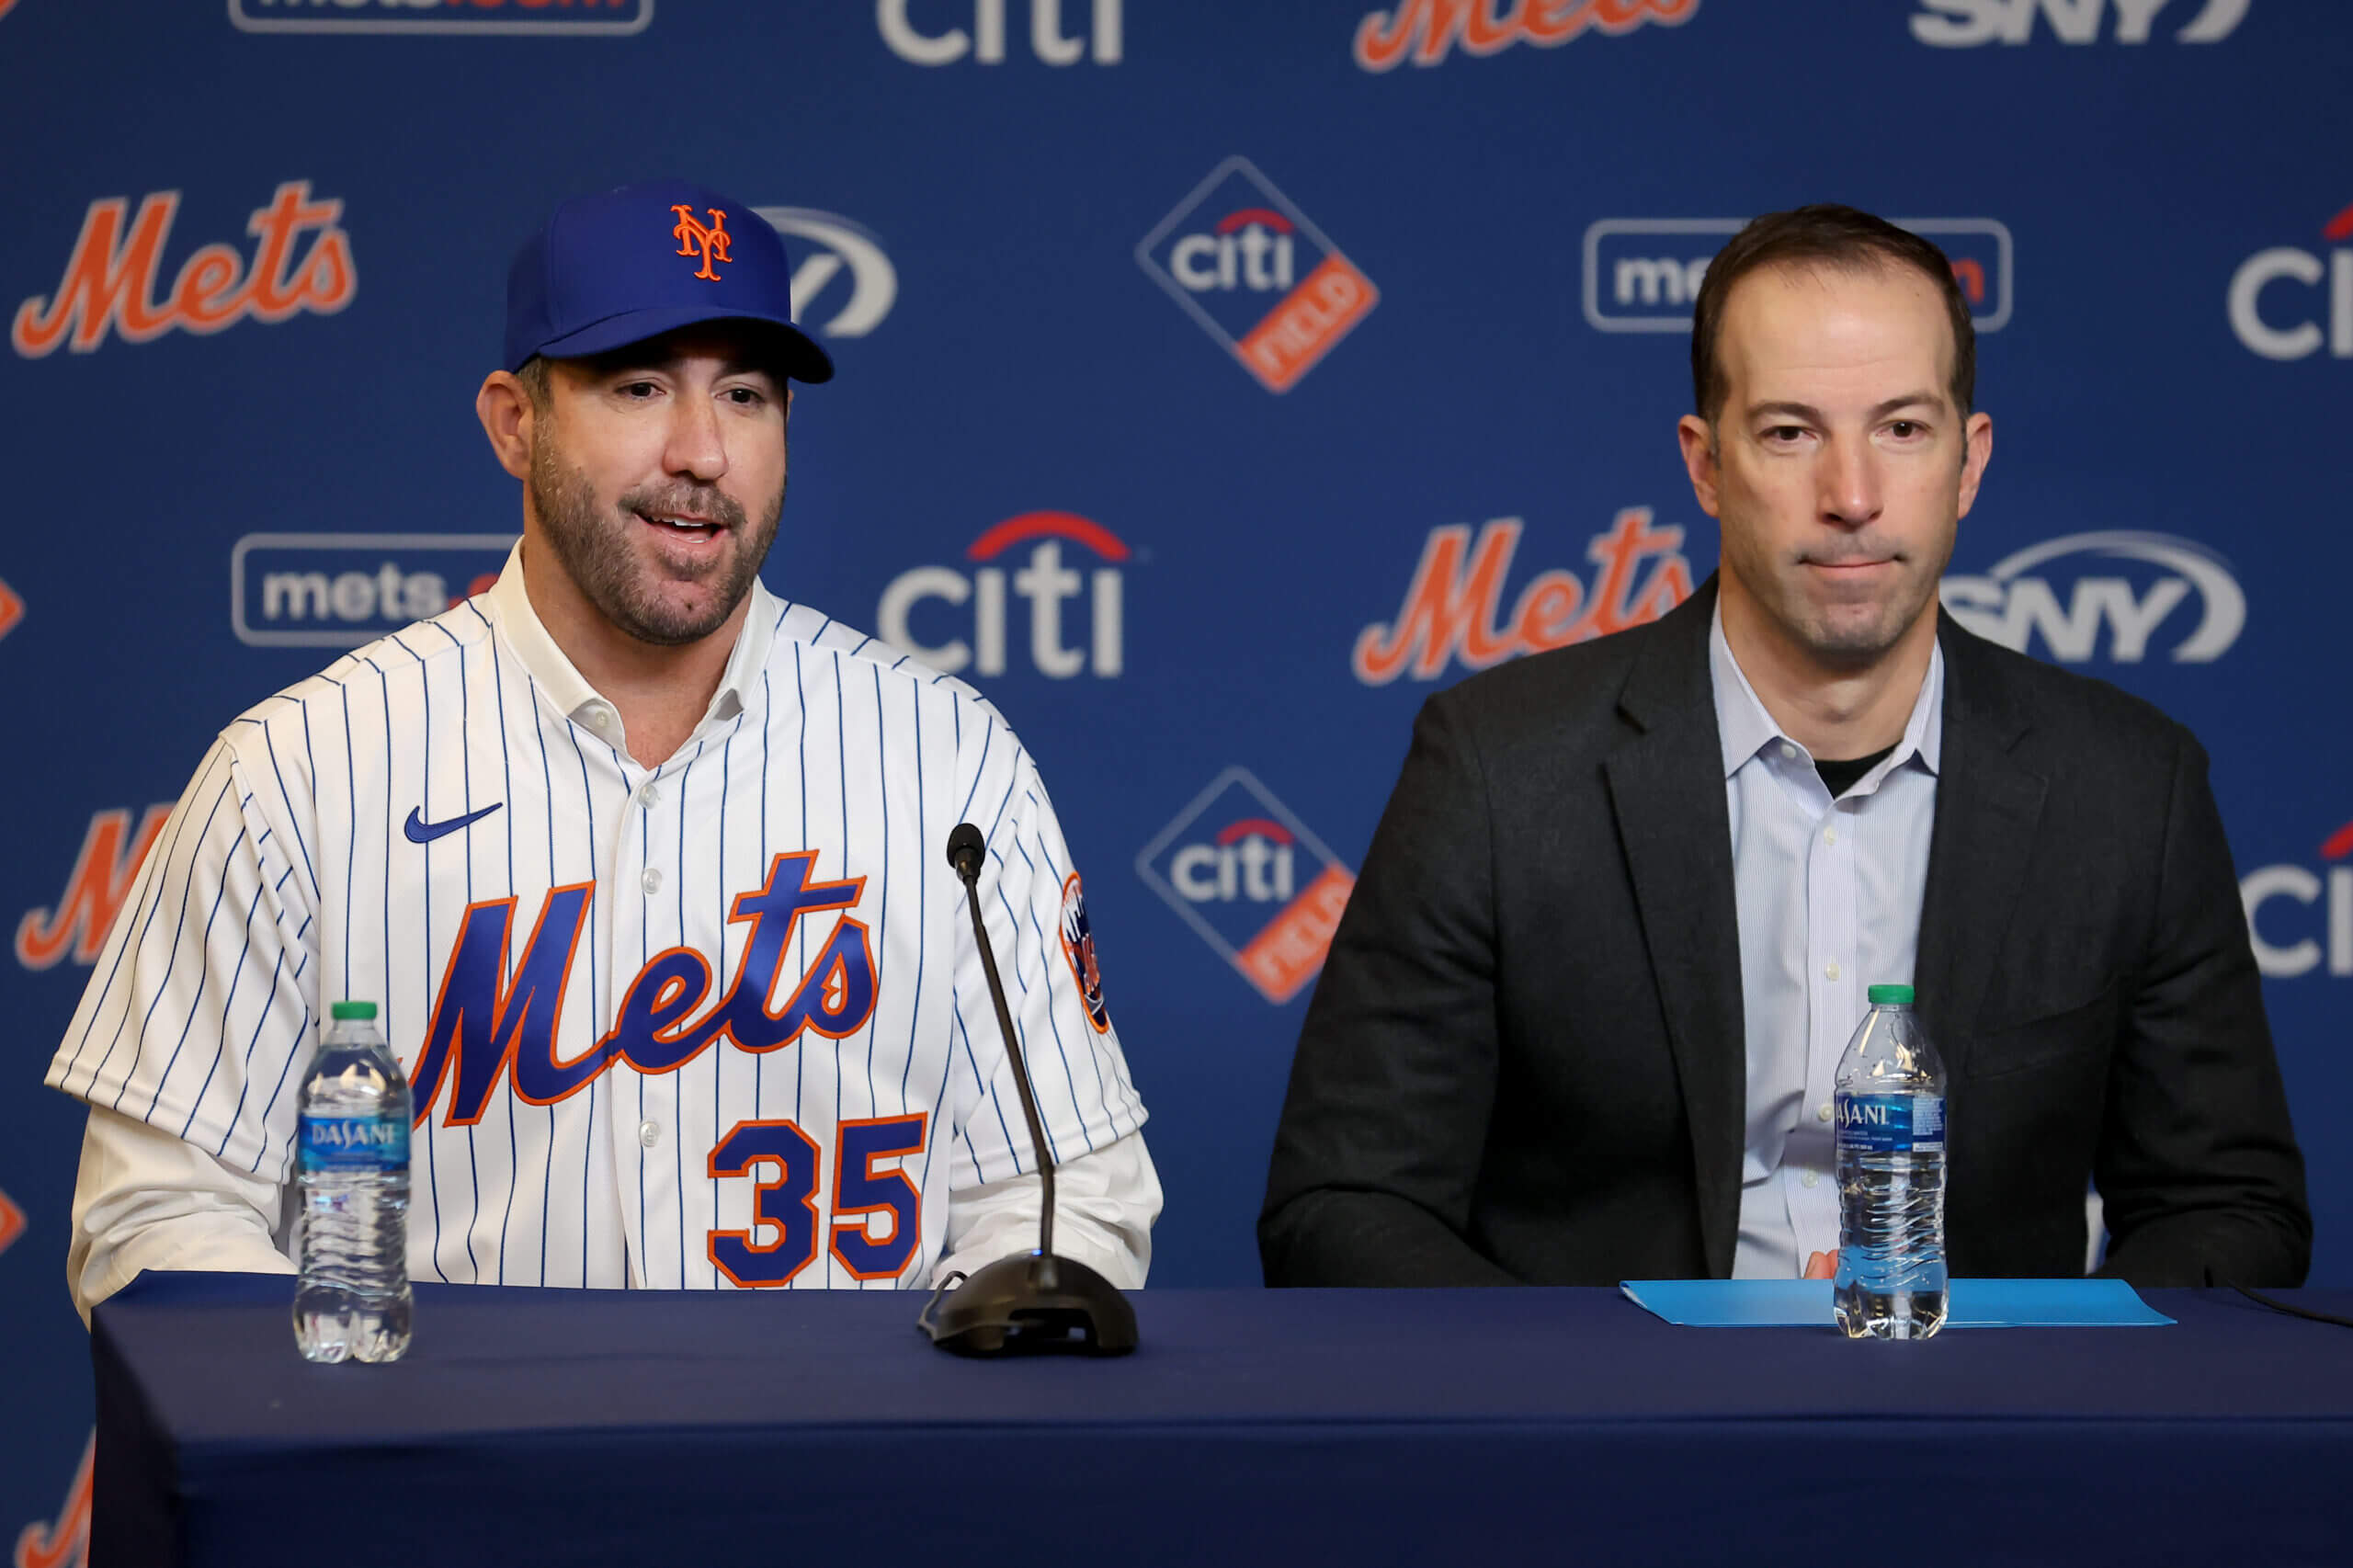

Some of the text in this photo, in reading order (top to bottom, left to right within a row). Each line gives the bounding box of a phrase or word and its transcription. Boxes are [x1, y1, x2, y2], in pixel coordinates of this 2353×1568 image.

[13, 181, 358, 358] Mets
[1170, 222, 1294, 291] citi
[264, 562, 499, 621] mets.
[878, 539, 1123, 678] citi
[1938, 576, 2188, 662] SNY
[1170, 833, 1294, 902] citi
[397, 848, 878, 1131] Mets
[313, 1119, 394, 1150] DASANI
[1838, 1098, 1887, 1129] ASANI
[707, 1111, 927, 1289] 35
